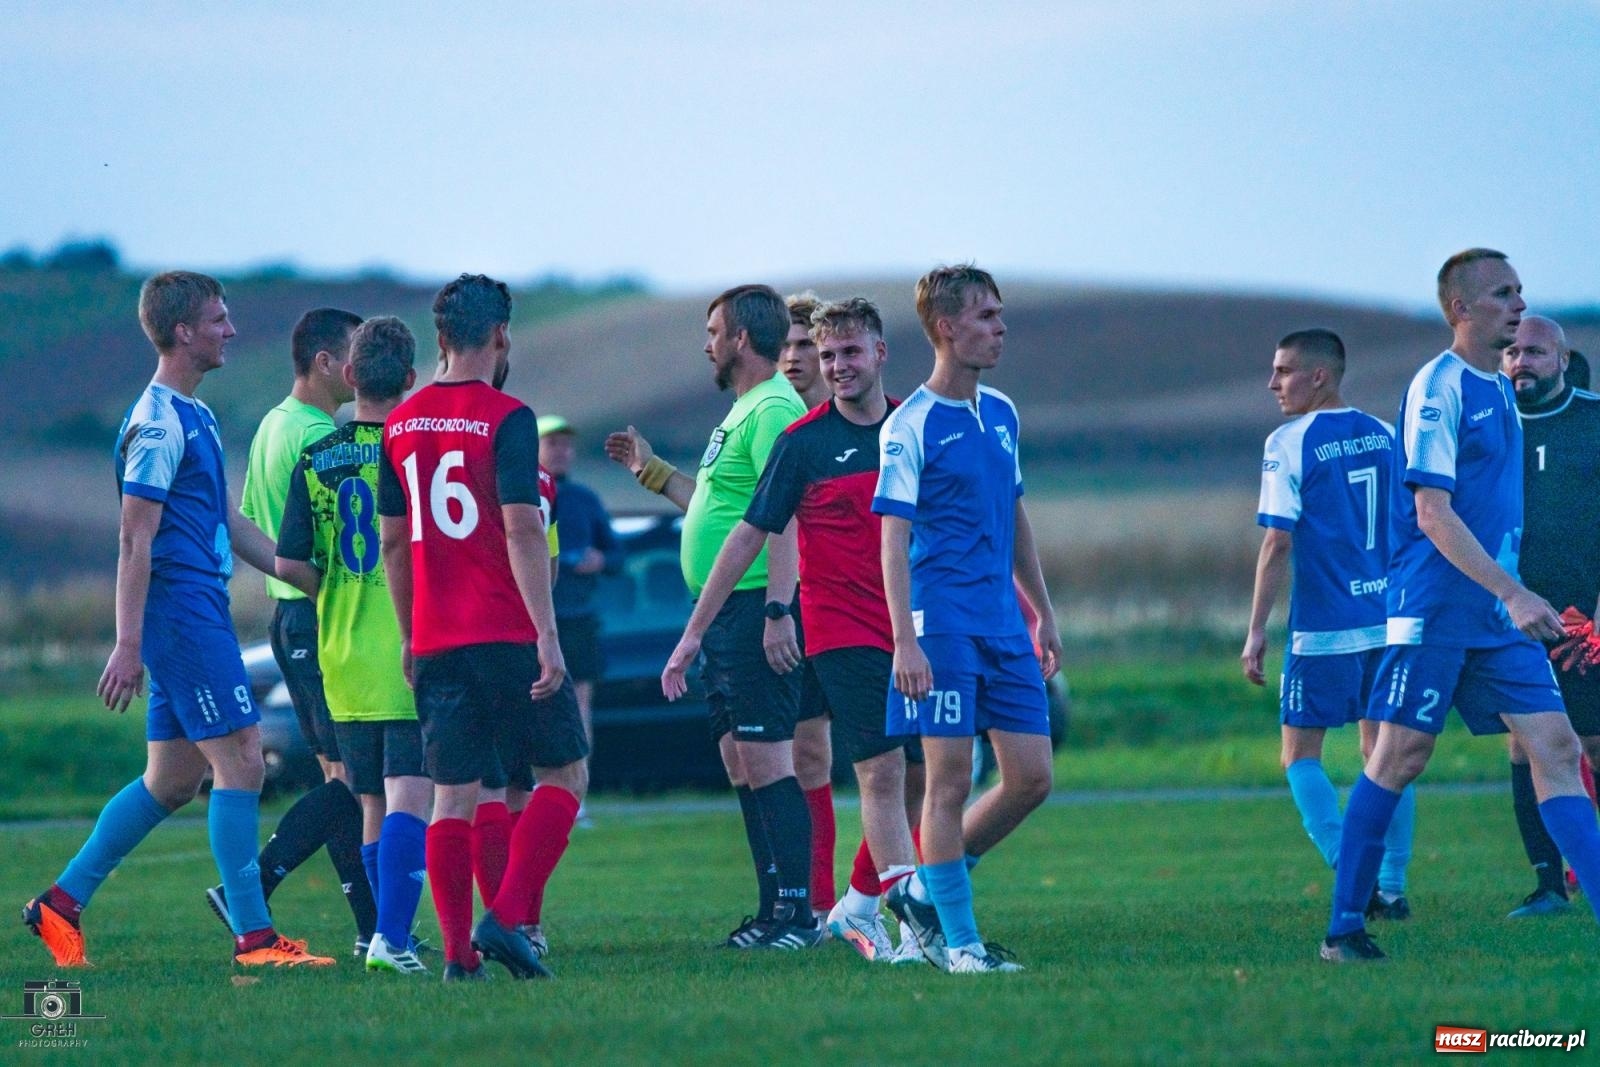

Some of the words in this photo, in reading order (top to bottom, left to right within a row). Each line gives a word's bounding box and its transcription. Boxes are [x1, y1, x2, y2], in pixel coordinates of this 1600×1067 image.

[404, 417, 490, 437] GRZEGORZOWICE
[1315, 441, 1342, 463] UNIA
[1535, 445, 1546, 472] 1
[401, 450, 479, 543] 16
[1347, 466, 1377, 551] 7
[337, 476, 380, 575] 8
[233, 685, 252, 714] 9
[930, 689, 961, 725] 79
[1416, 688, 1439, 722] 2
